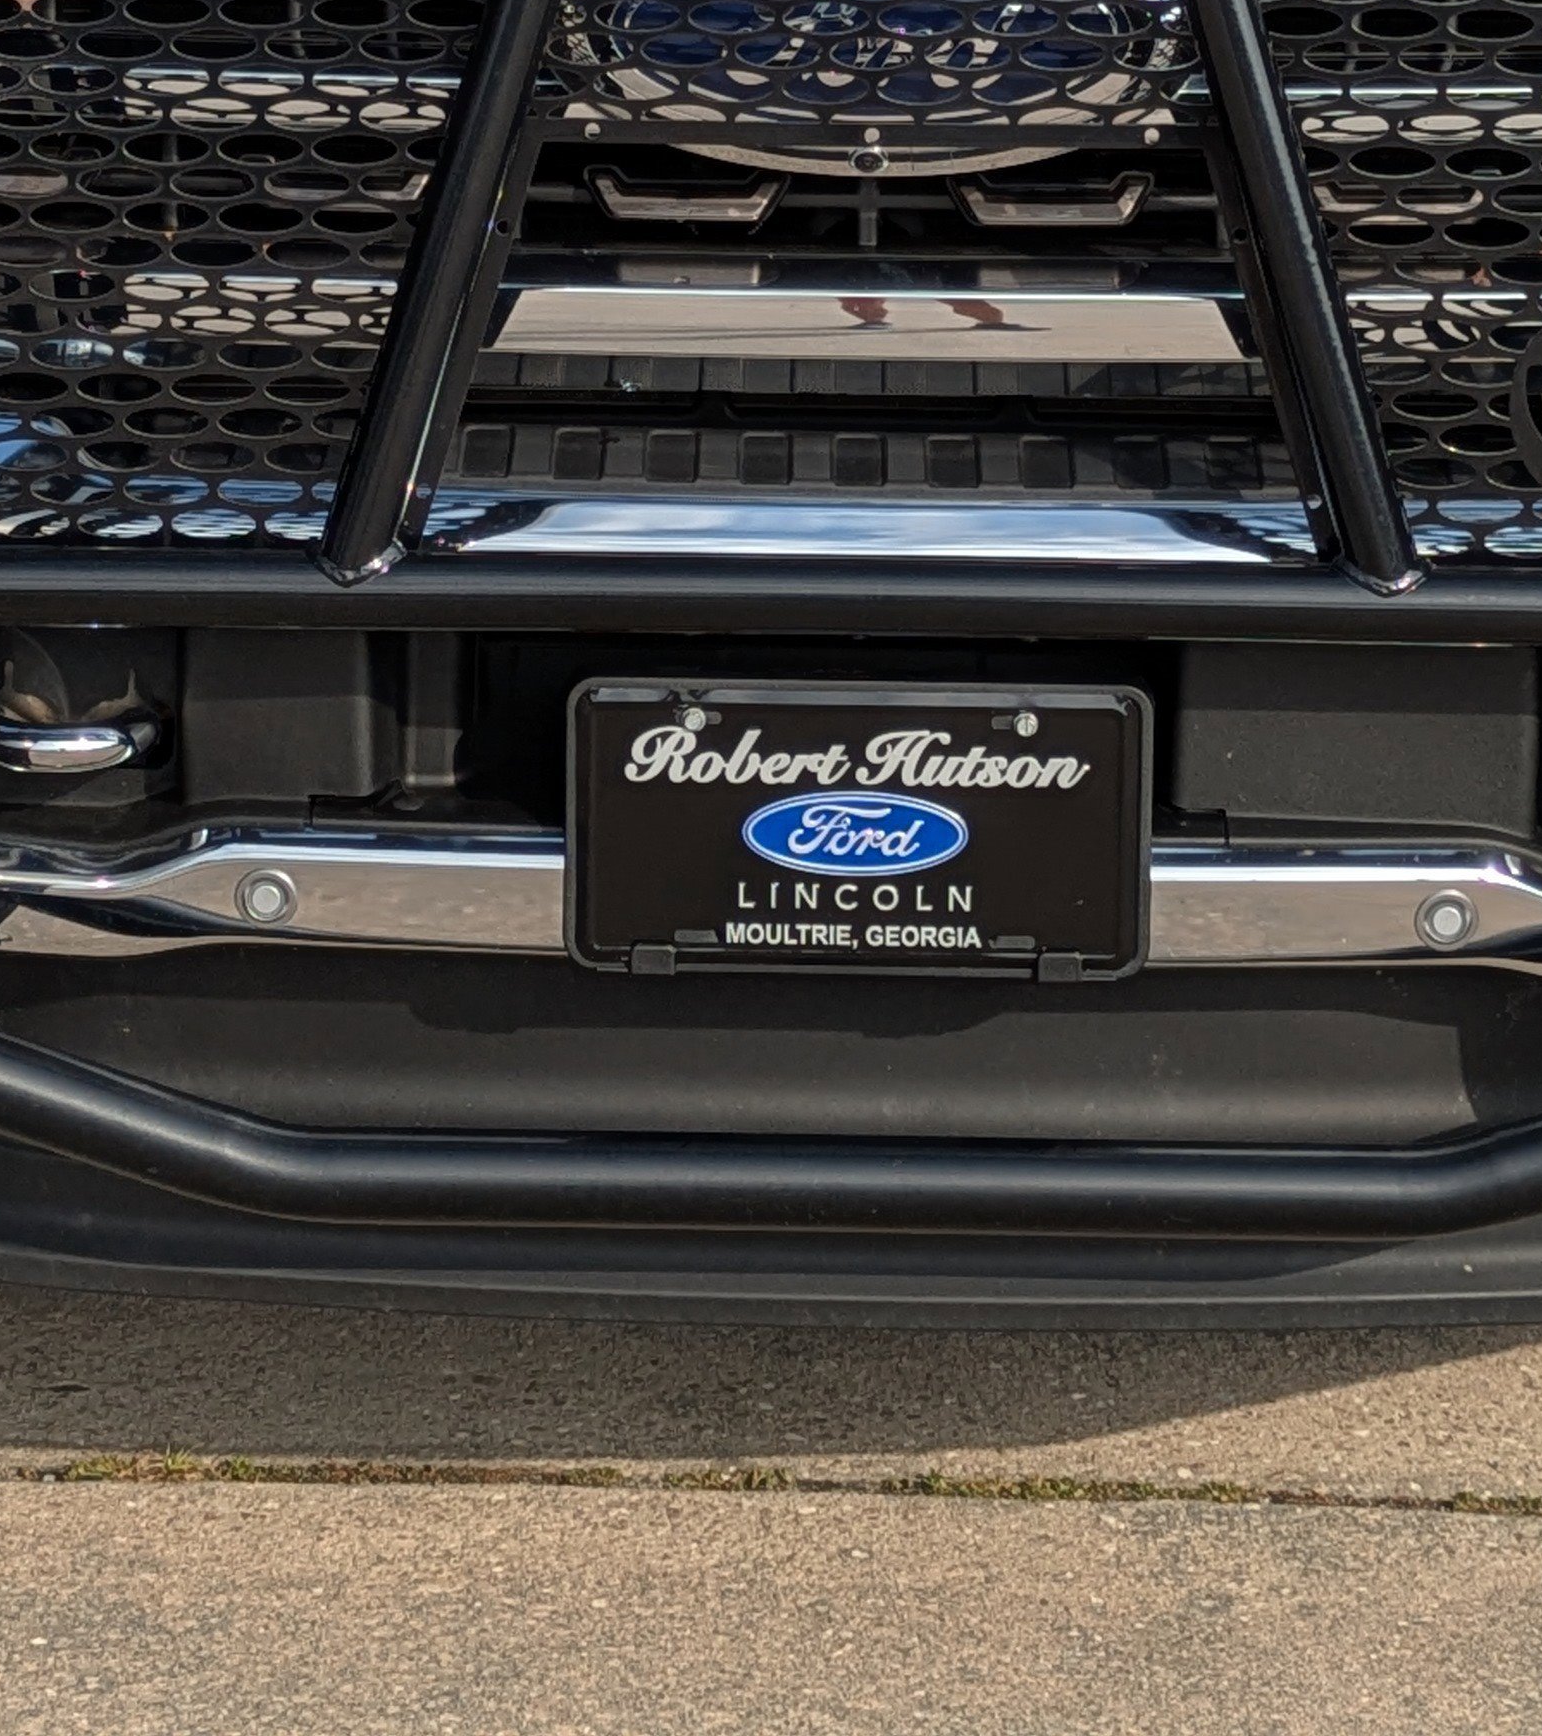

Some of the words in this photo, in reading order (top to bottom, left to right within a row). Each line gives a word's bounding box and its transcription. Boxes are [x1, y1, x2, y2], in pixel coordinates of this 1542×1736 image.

[624, 725, 851, 785] Robert
[856, 729, 1091, 790] Hutson
[787, 804, 925, 858] Ford
[738, 881, 974, 913] LINCOLN
[725, 922, 859, 950] MOULTRIE,
[865, 924, 983, 949] GEORGIA
